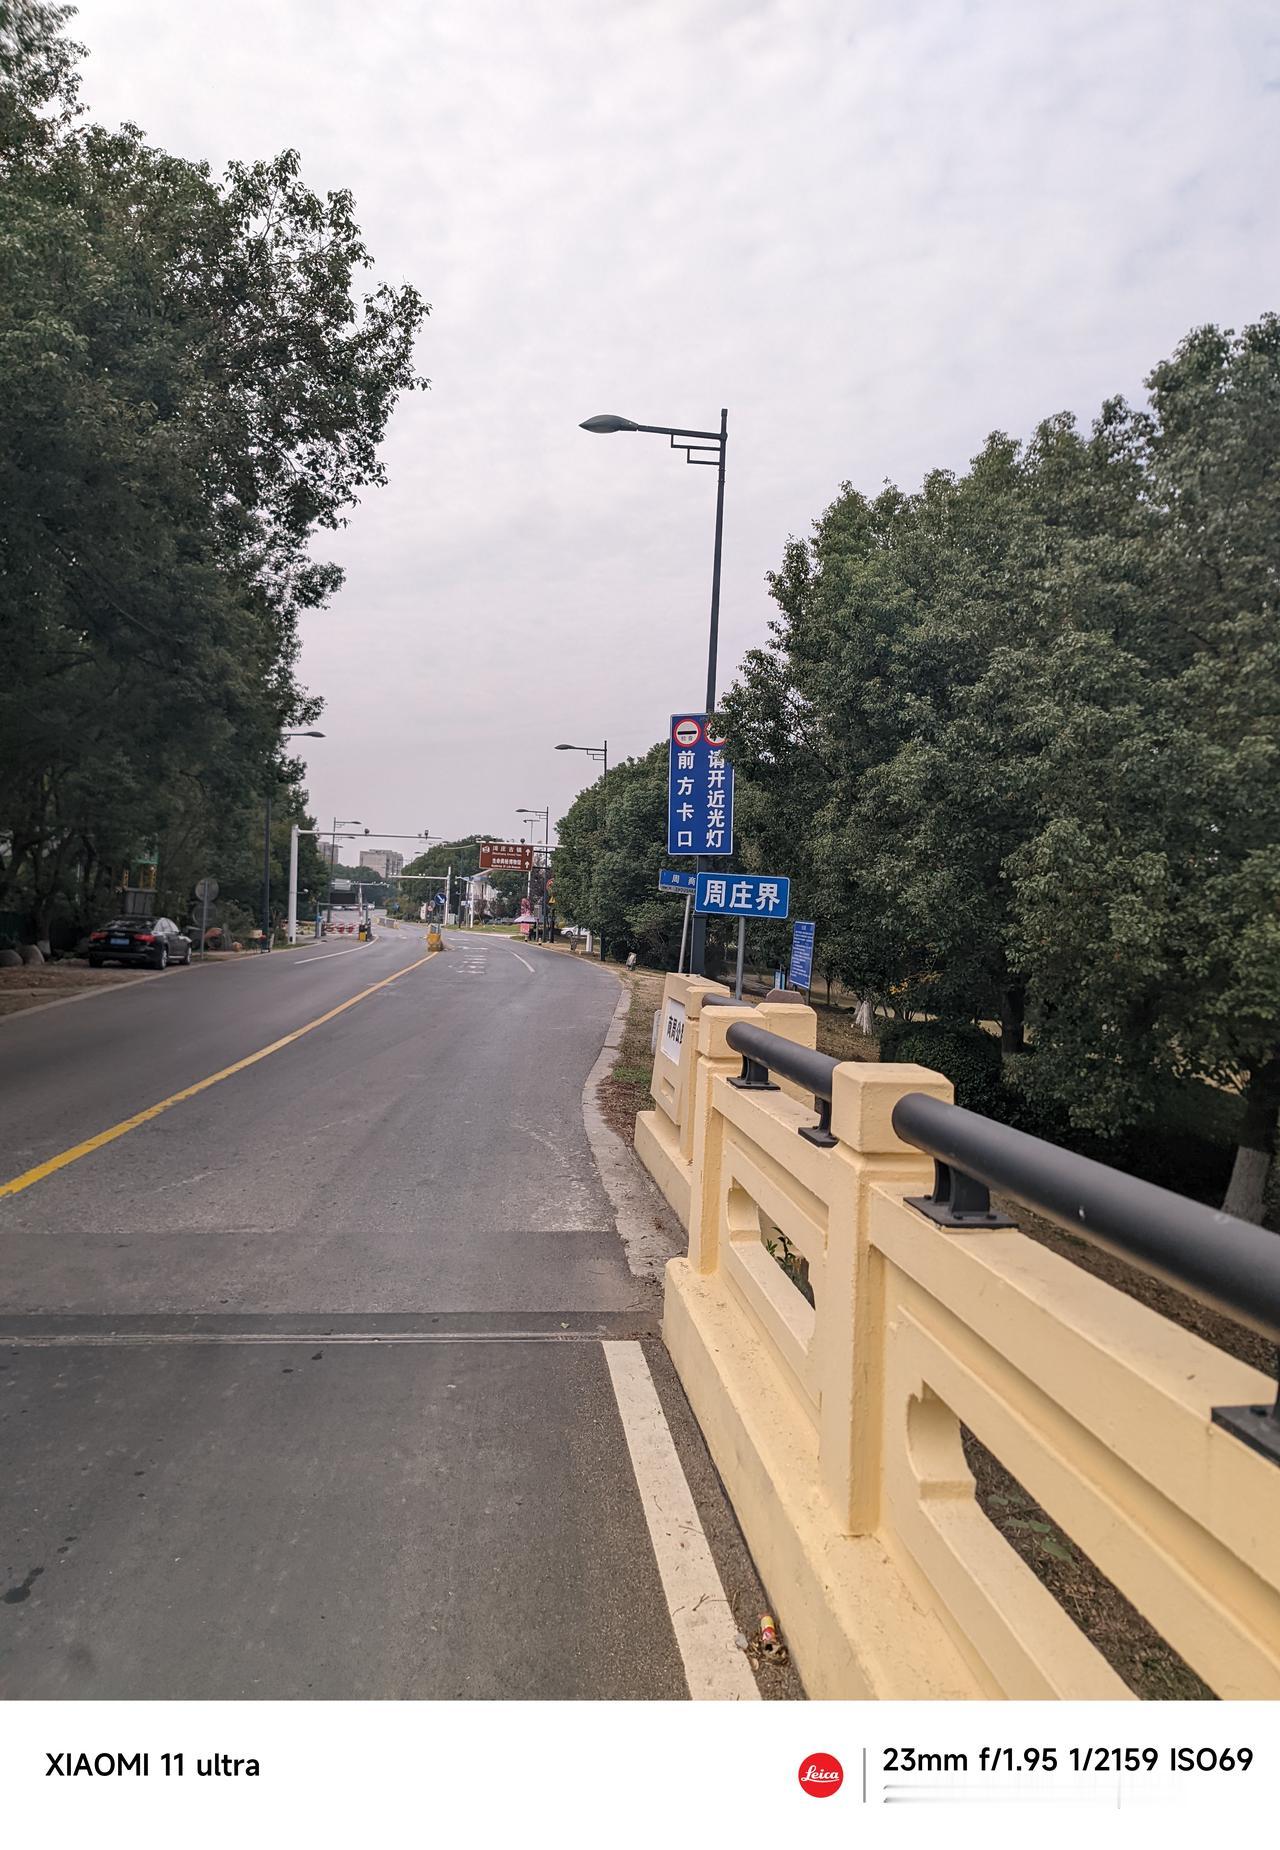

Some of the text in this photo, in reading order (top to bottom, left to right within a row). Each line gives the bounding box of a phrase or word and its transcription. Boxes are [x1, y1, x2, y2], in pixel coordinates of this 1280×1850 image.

[676, 750, 695, 847] 前方卡口
[706, 749, 726, 848] 请开近光灯
[703, 880, 780, 912] 周庄界
